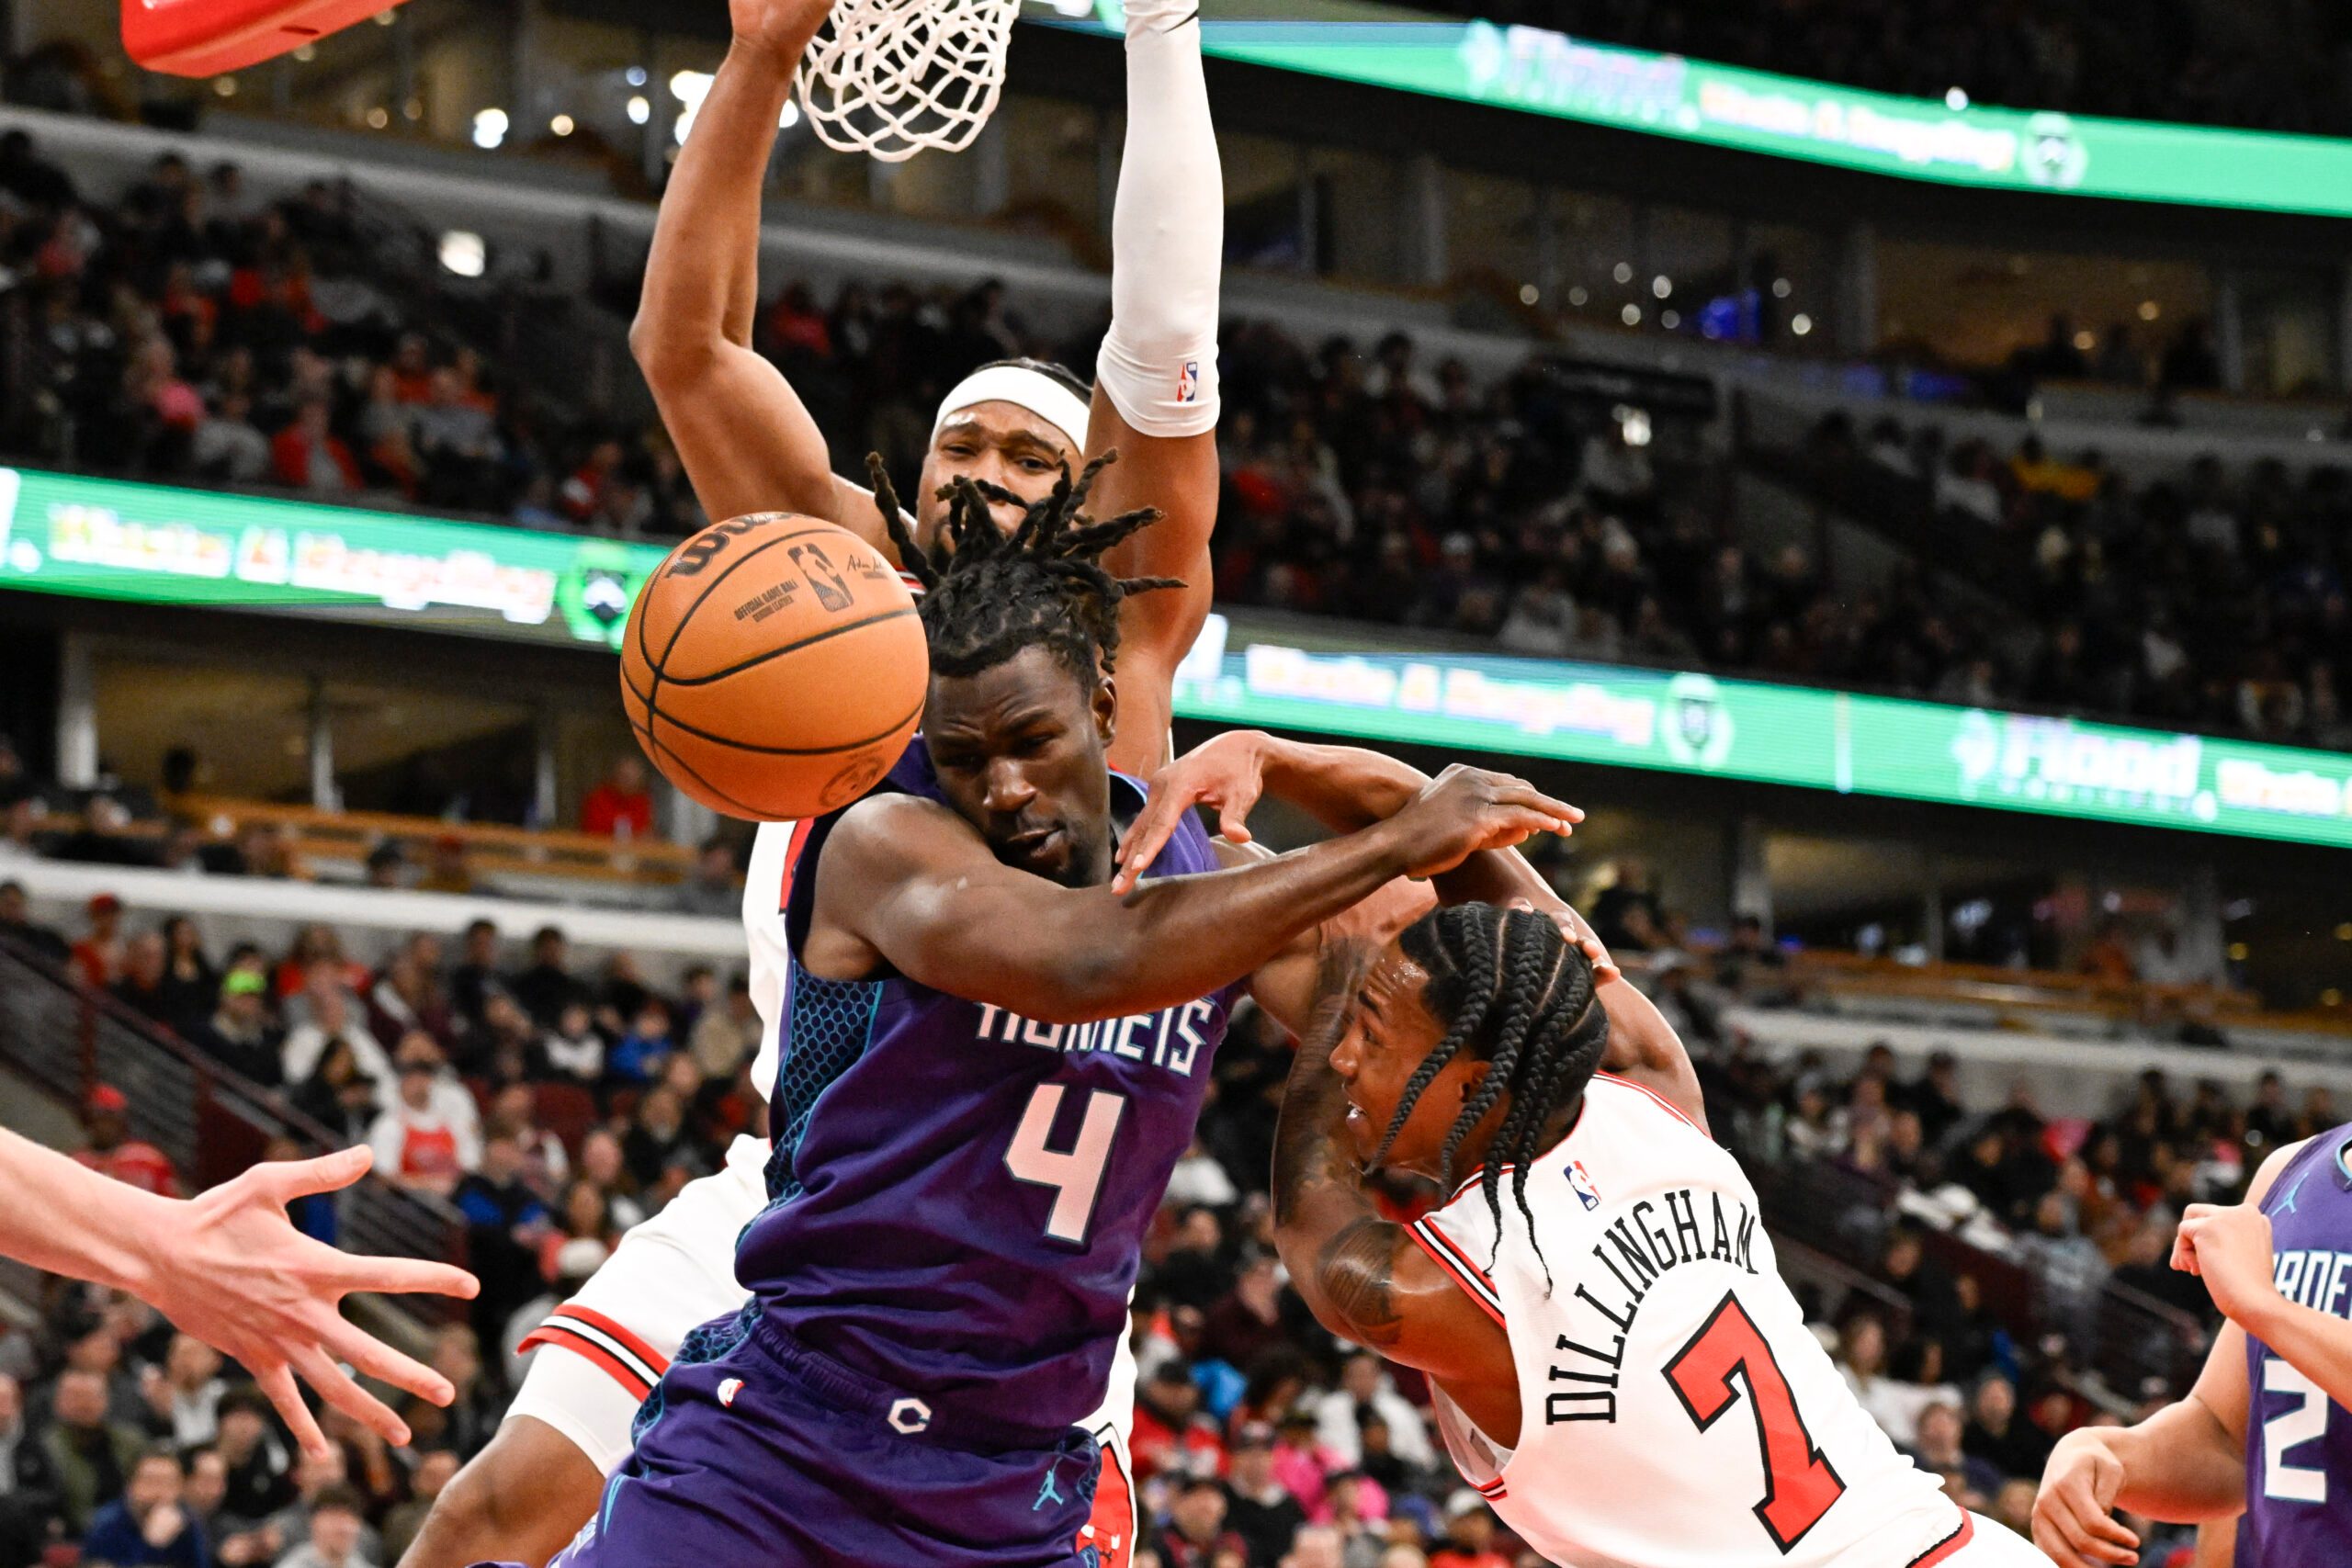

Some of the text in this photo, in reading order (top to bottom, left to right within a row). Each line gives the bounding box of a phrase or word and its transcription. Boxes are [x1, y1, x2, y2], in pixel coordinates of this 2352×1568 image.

[1002, 1082, 1127, 1246] 4
[1546, 1190, 1759, 1425] DILLINGHAM
[1660, 1289, 1847, 1555] 7
[2263, 1358, 2329, 1503] 2
